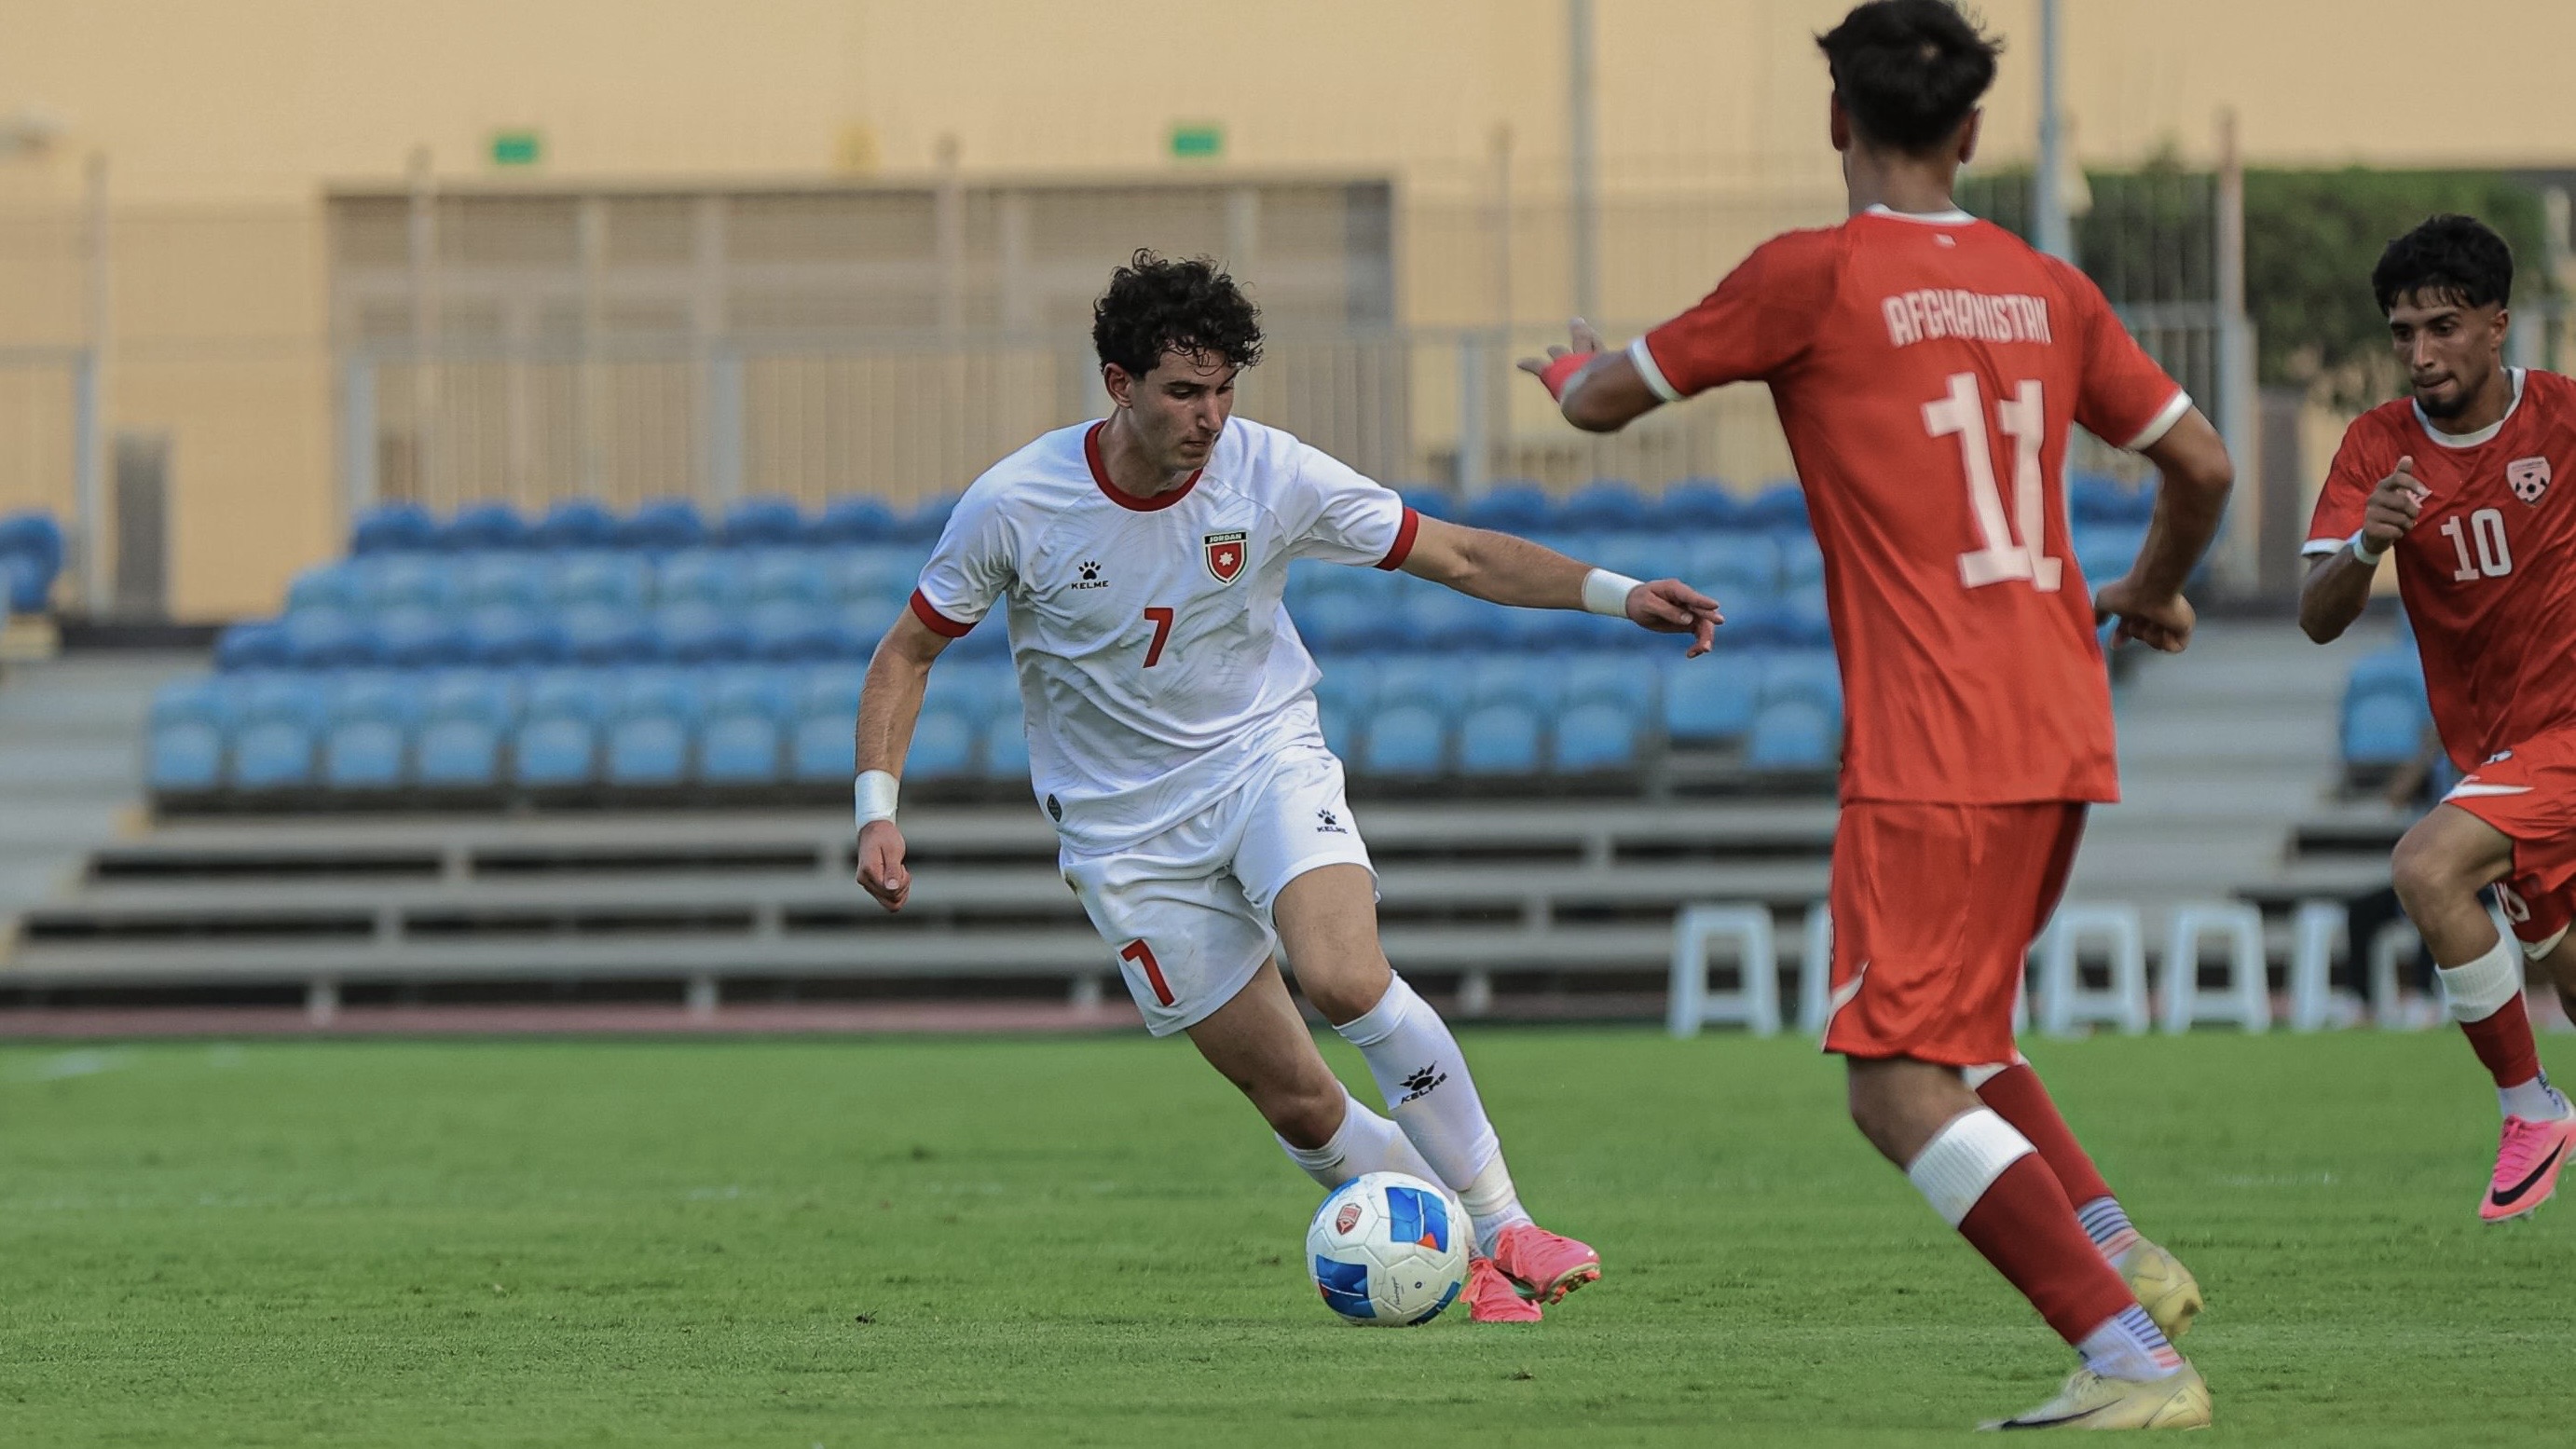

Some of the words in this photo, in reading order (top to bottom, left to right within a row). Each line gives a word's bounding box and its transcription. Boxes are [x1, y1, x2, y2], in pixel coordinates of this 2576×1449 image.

[1883, 289, 2051, 347] AFGHANISTAN
[1922, 372, 2062, 592] 11
[1209, 533, 1241, 543] JORDAN
[2441, 508, 2512, 581] 10
[1071, 581, 1109, 589] KELME
[1143, 608, 1173, 668] 7
